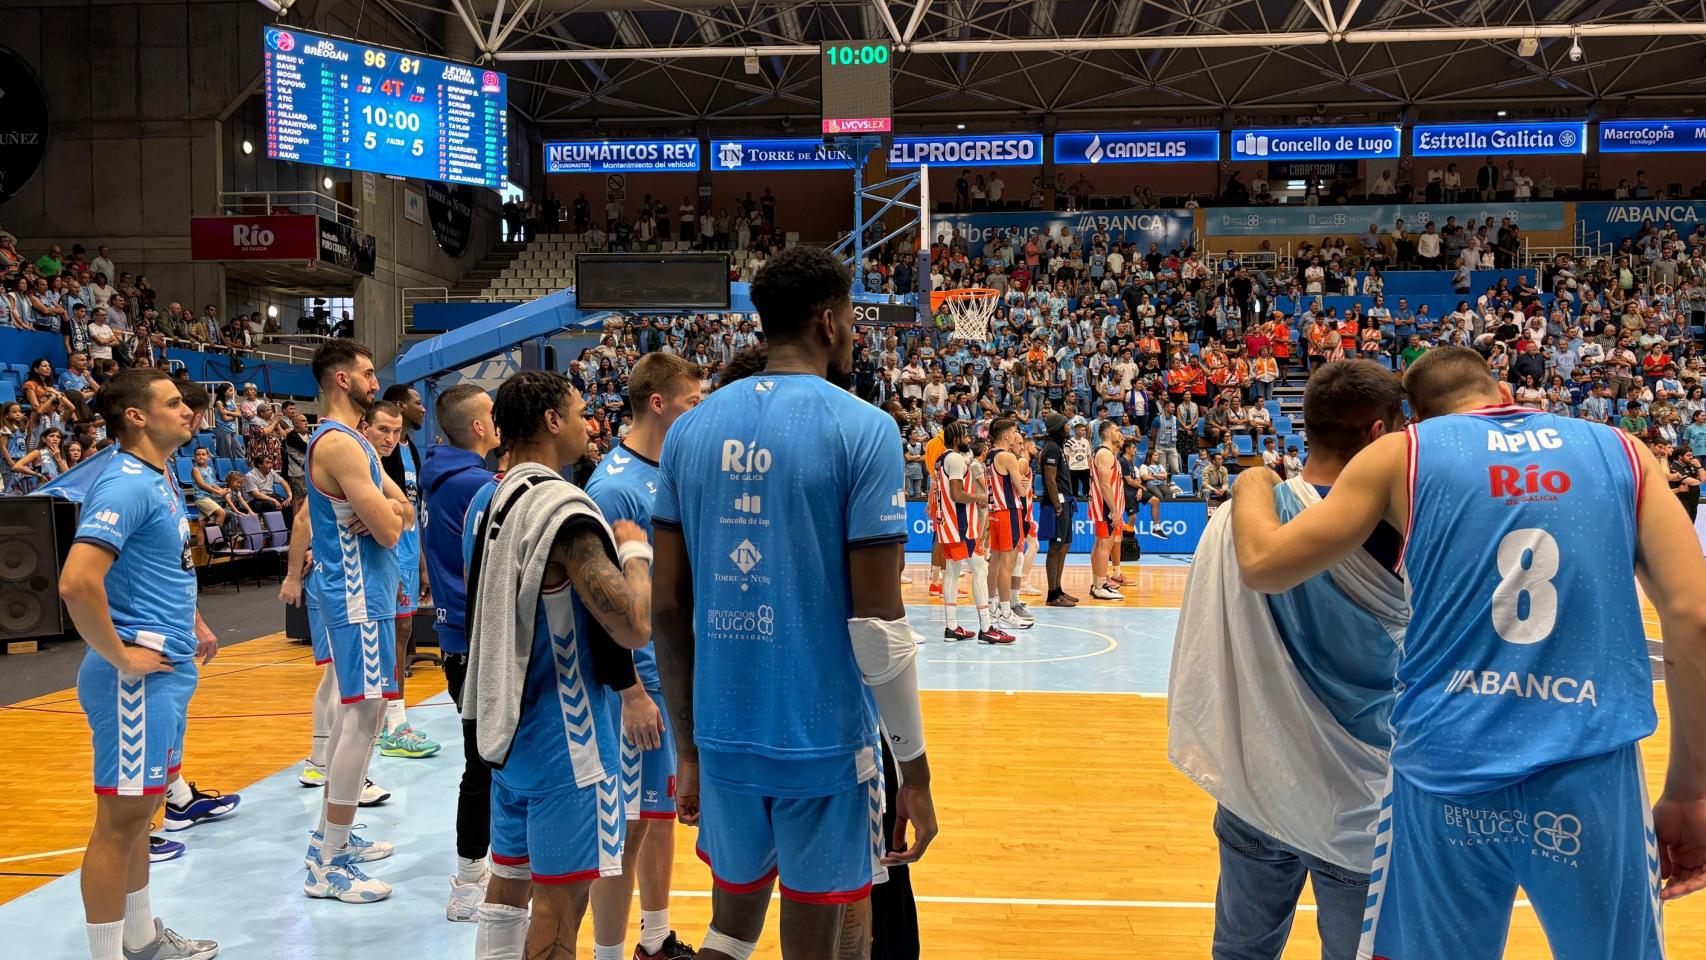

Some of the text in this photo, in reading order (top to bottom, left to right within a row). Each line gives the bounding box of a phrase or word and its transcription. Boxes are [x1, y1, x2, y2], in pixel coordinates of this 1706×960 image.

[318, 40, 334, 51] RÍO
[276, 54, 297, 63] MRSIC
[304, 45, 348, 61] BREOGÁN
[364, 50, 386, 68] 96
[827, 45, 888, 65] 10:00
[276, 62, 297, 71] DAVIS
[400, 57, 420, 75] 81
[445, 65, 471, 77] LEYMA
[276, 70, 301, 80] MOORE
[277, 78, 306, 89] POPOVIC
[277, 86, 292, 94] VILA
[381, 79, 404, 97] 4T
[277, 94, 293, 103] ATIC
[277, 103, 293, 111] APIC
[278, 110, 307, 121] HILLIARD
[362, 105, 420, 132] 10:00
[0, 130, 39, 145] UÑEZ
[278, 127, 301, 136] SAKHO
[364, 131, 377, 150] 5
[411, 139, 424, 156] 5
[1271, 136, 1392, 154] Concello de Lugo
[1418, 130, 1554, 149] Estrella Galicia
[279, 143, 294, 151] ONU
[550, 143, 696, 161] NEUMÁTICOS REY
[890, 140, 1034, 162] ELPROGRESO
[1105, 141, 1186, 158] CANDELAS
[279, 151, 300, 160] NAKIC
[748, 149, 794, 160] TORRE
[603, 161, 652, 169] Mantenimiento
[667, 160, 696, 168] vehículo
[233, 224, 275, 247] Río
[1487, 428, 1563, 452] APIC
[722, 439, 771, 473] Río
[1488, 464, 1571, 498] Río
[1520, 495, 1558, 503] GALICIA
[720, 516, 746, 524] Concello
[748, 517, 758, 525] de
[1492, 528, 1560, 644] 8
[716, 617, 755, 631] LUGO
[1445, 814, 1464, 828] DE
